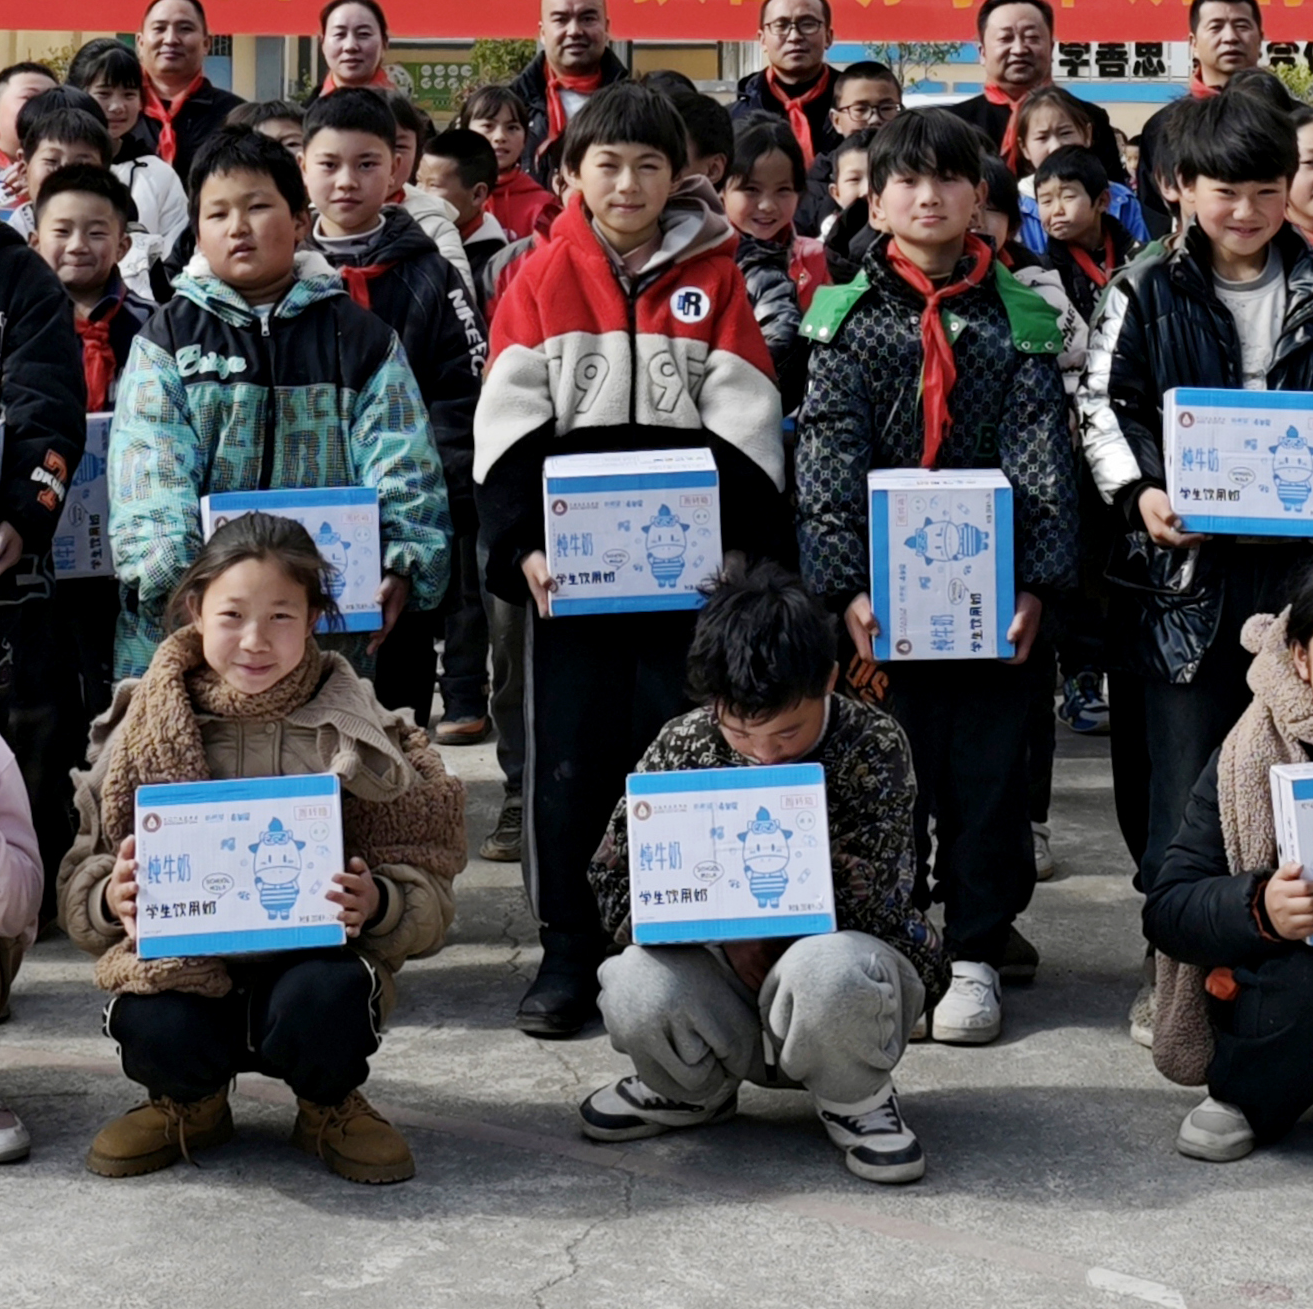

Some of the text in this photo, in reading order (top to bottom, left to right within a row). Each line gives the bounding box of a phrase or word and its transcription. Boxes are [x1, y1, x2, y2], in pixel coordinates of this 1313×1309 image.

[1182, 447, 1219, 472] 纯牛奶
[1180, 487, 1241, 501] 学生饮用奶
[90, 514, 101, 569] 学生饮用奶
[557, 533, 593, 557] 纯牛奶
[556, 571, 615, 585] 学生饮用奶
[930, 614, 955, 651] 纯牛奶
[970, 593, 983, 652] 学生饮用奶
[148, 854, 191, 884] 纯牛奶
[639, 842, 683, 871] 纯牛奶
[638, 888, 708, 906] 学生饮用奶
[145, 901, 217, 919] 学生饮用奶
